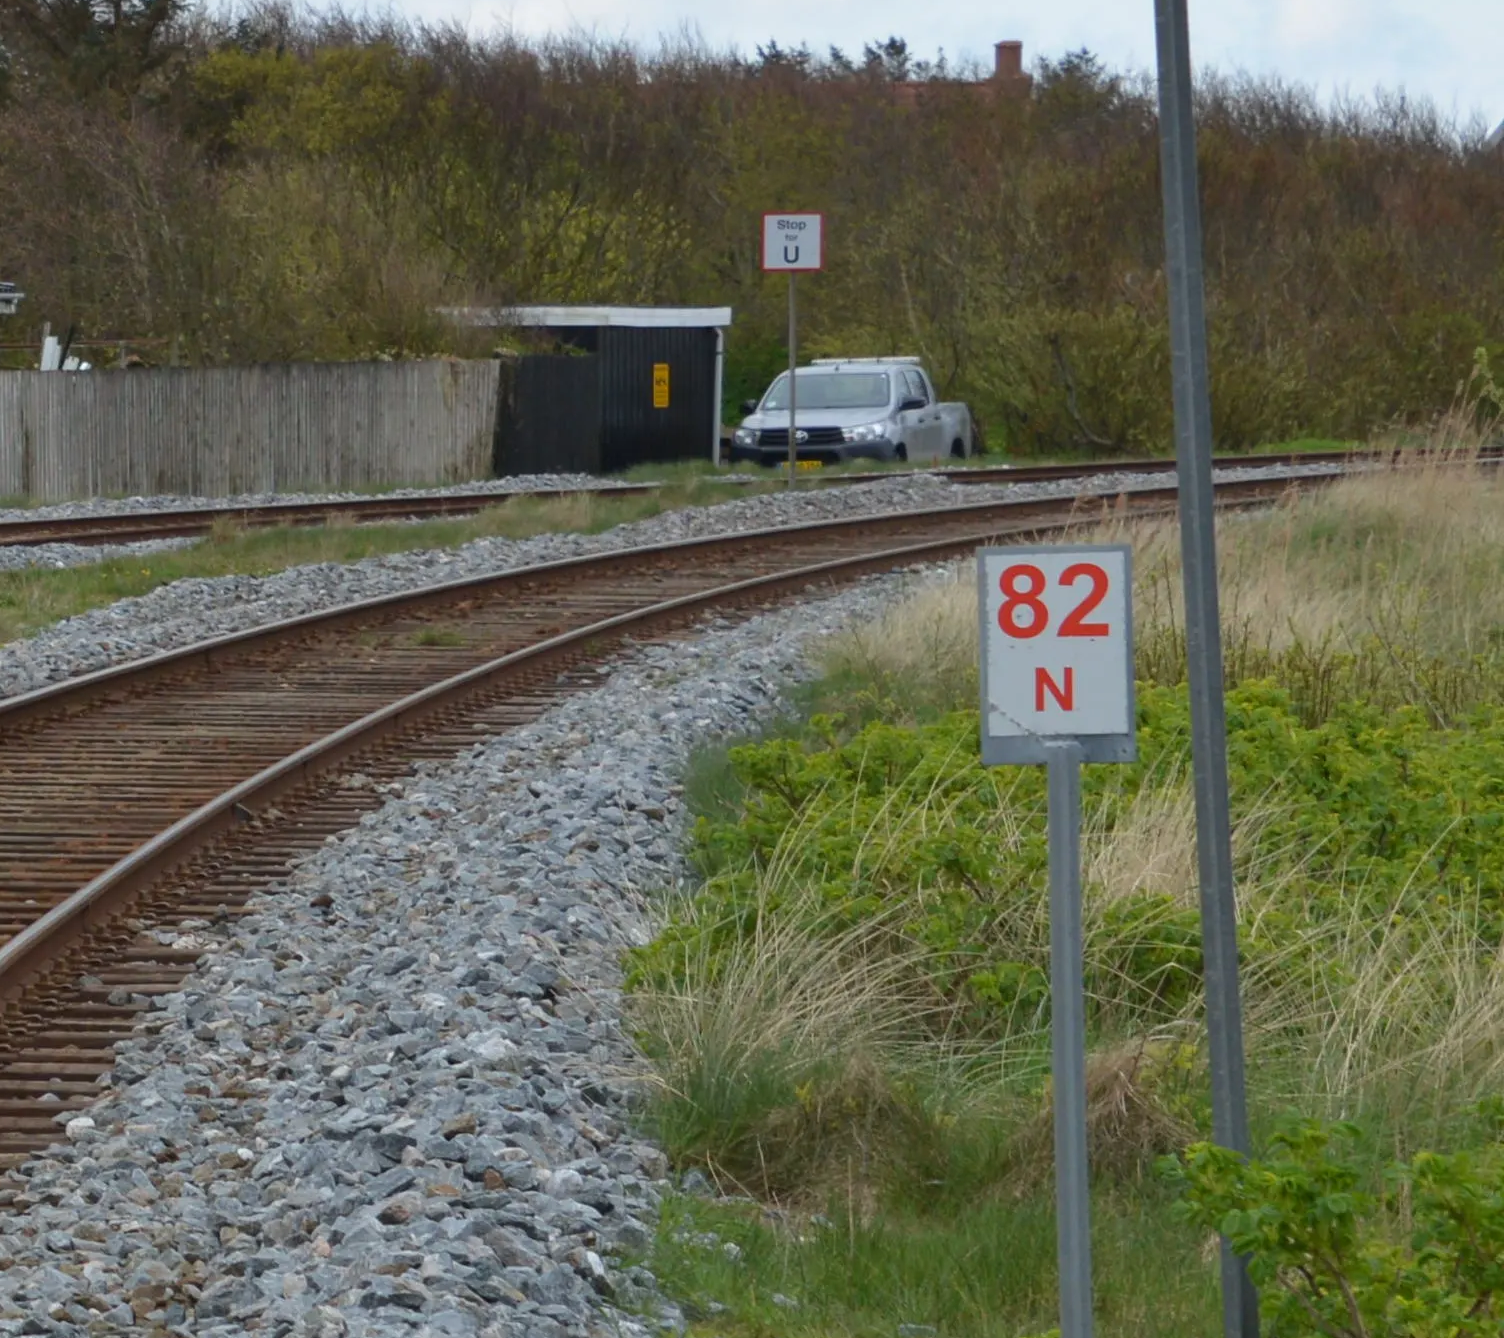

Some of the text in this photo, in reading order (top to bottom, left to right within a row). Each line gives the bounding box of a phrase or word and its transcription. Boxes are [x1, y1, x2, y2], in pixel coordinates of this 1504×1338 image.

[776, 219, 807, 232] Stop
[784, 233, 799, 242] for
[783, 245, 799, 264] U
[997, 562, 1110, 639] 82
[1034, 666, 1074, 712] N
